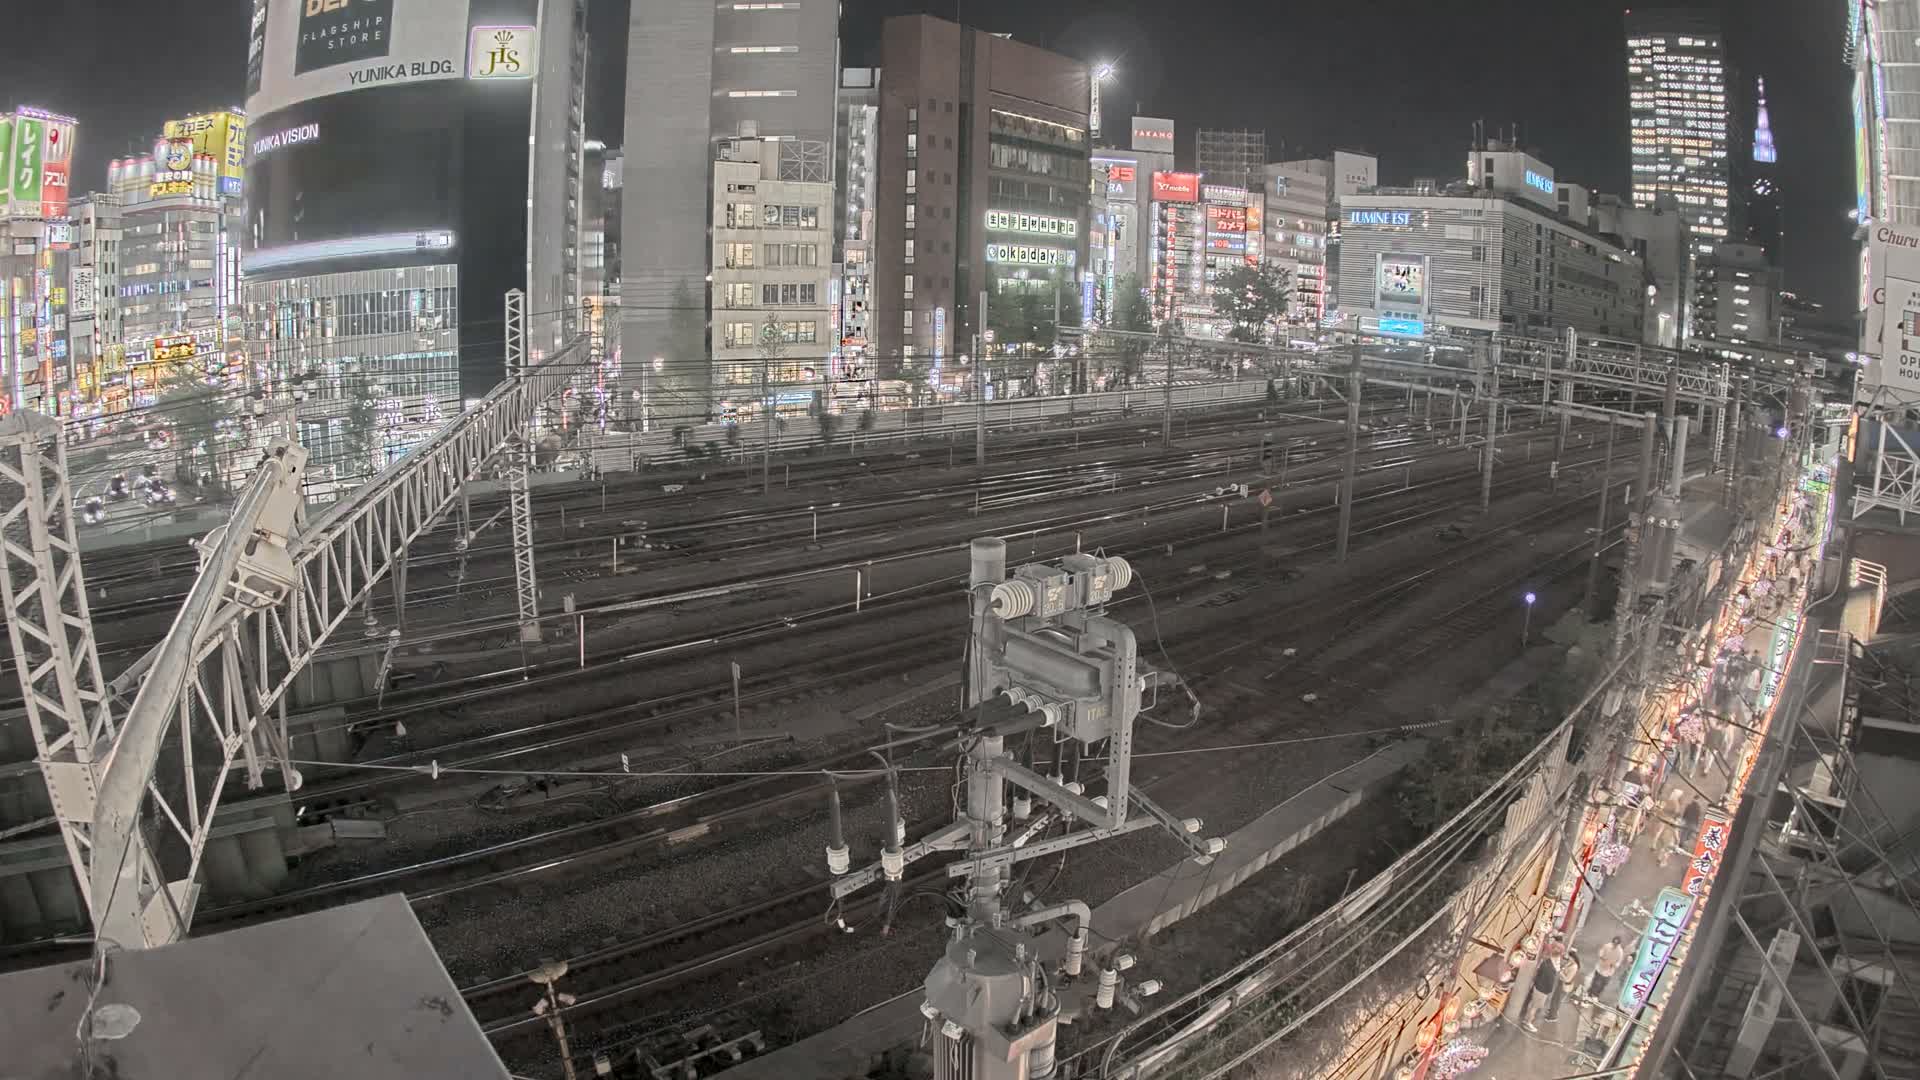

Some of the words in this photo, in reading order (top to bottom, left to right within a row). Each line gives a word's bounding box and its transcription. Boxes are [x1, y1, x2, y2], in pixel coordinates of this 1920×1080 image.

[302, 16, 382, 45] FLAGSHIP
[327, 31, 381, 50] STORE
[348, 64, 407, 86] YUNIKA
[411, 60, 456, 77] BLDG.
[253, 134, 281, 155] YUNIKA
[281, 123, 319, 145] VISION
[20, 122, 36, 190] レイク
[1208, 207, 1246, 220] ヨドバシ
[1351, 211, 1390, 224] LUMINE
[1392, 212, 1410, 225] EST
[1217, 219, 1246, 232] カメラ
